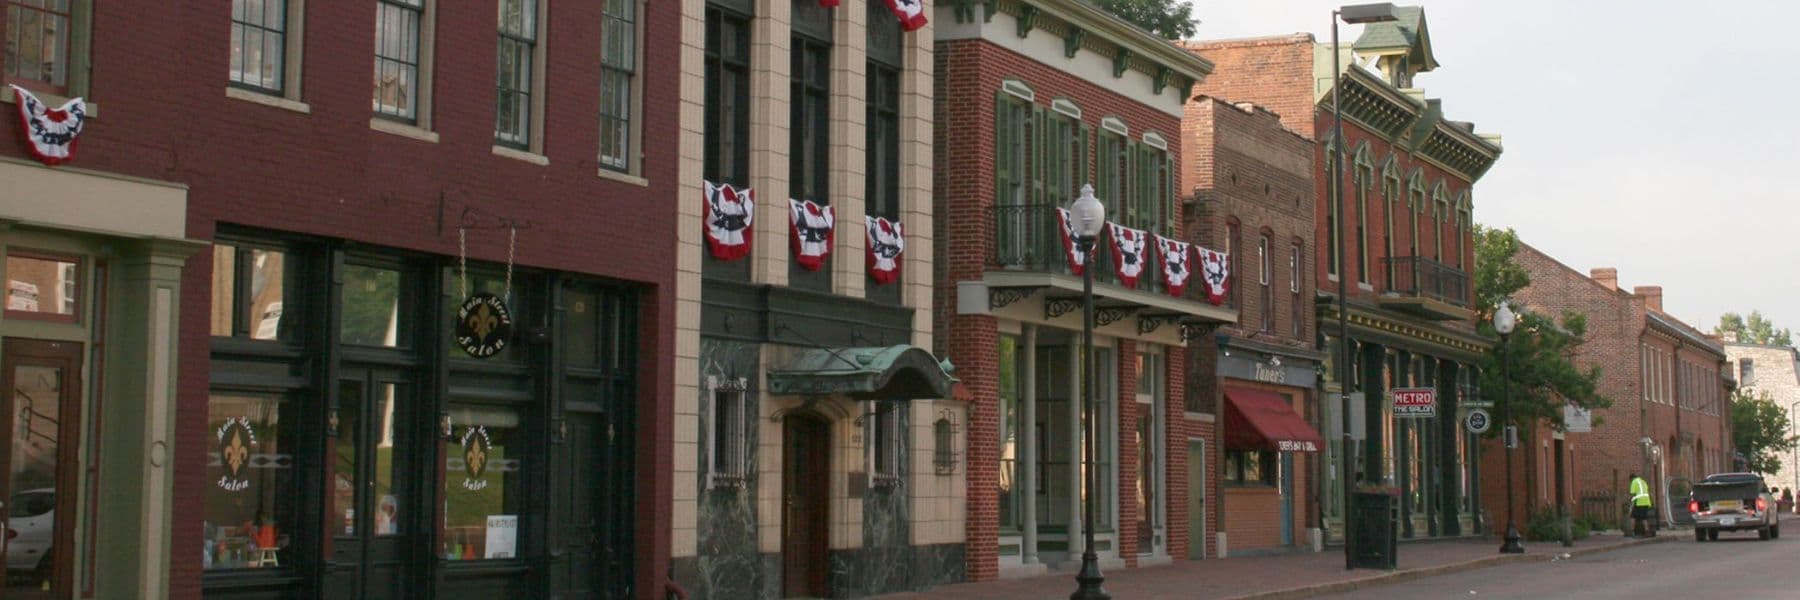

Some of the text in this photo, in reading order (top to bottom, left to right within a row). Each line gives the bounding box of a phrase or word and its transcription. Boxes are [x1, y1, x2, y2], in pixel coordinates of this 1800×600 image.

[459, 296, 511, 325] Main Street
[459, 336, 504, 356] Salon
[1394, 392, 1431, 404] METRO
[217, 416, 236, 442] Main
[218, 475, 249, 491] Salon
[463, 477, 487, 491] Salon
